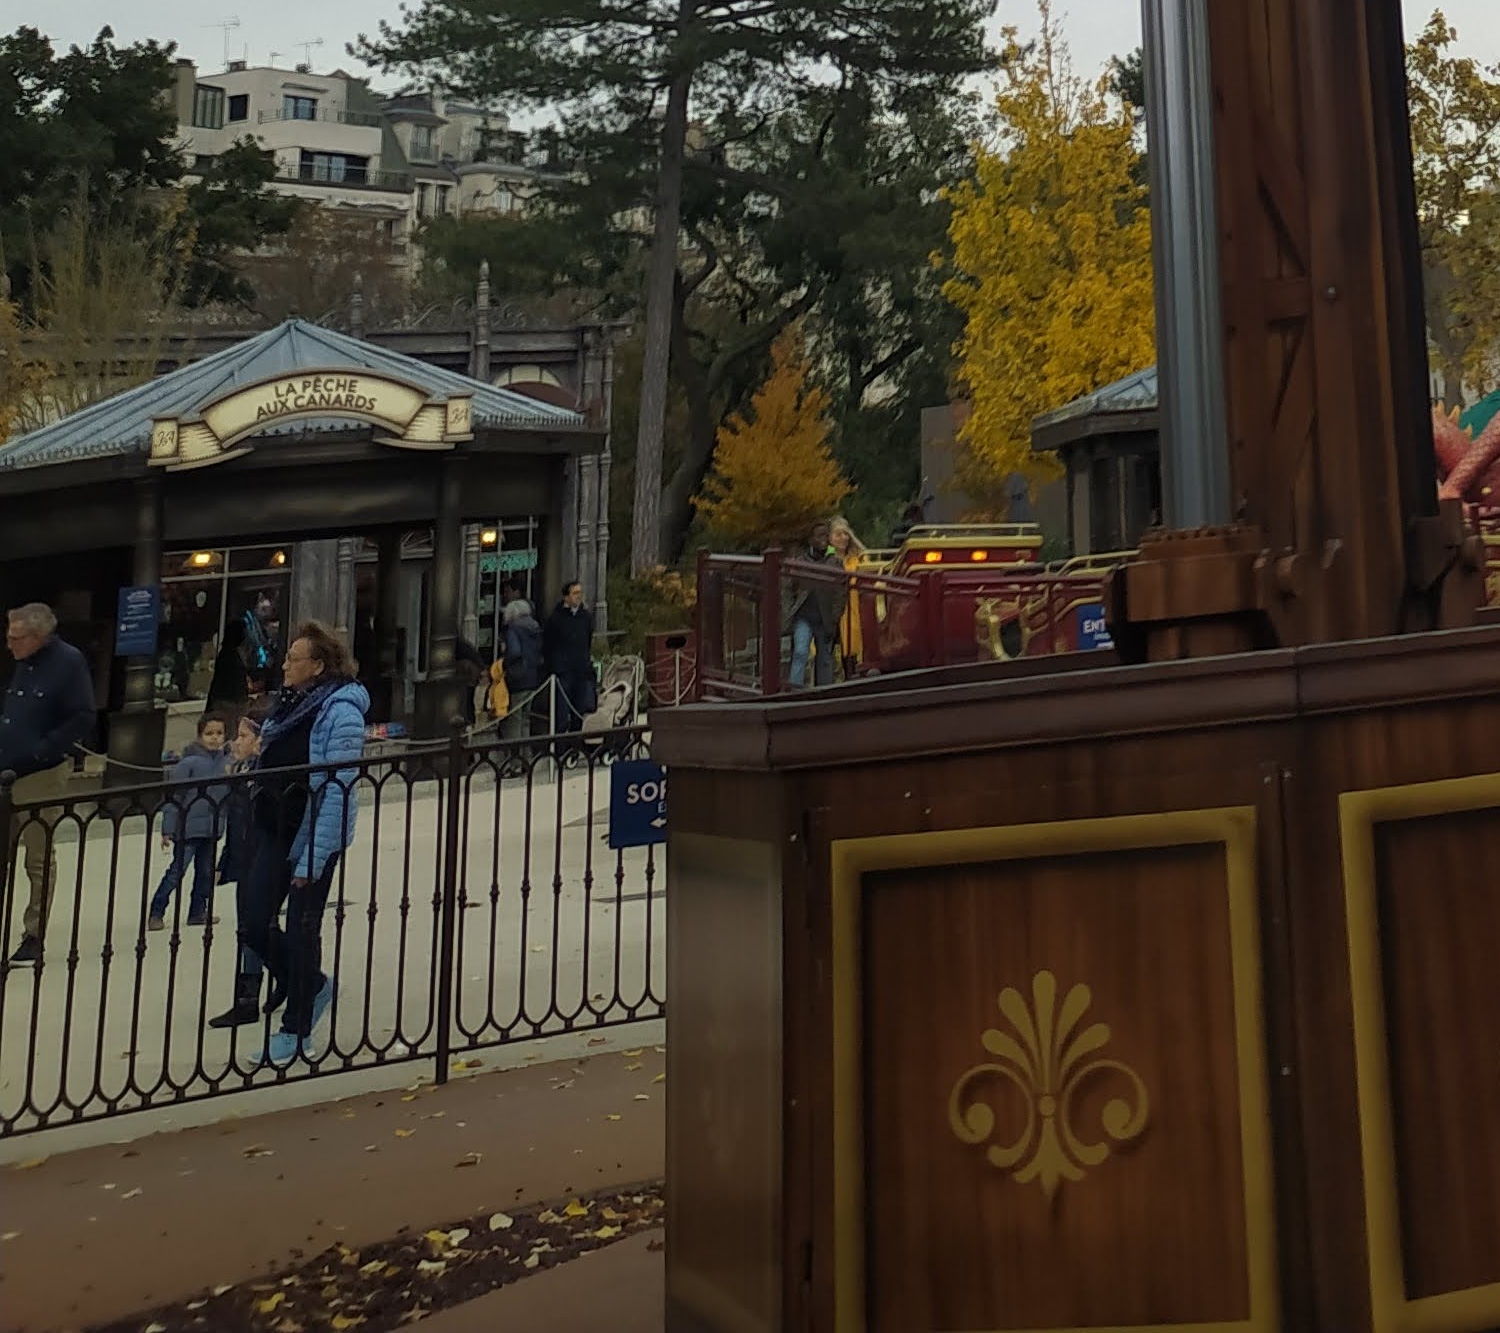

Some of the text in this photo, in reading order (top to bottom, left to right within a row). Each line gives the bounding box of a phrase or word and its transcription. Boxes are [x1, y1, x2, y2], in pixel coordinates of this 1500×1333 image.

[274, 376, 358, 398] LA PÊCHE
[256, 394, 378, 420] AUX CANARDS
